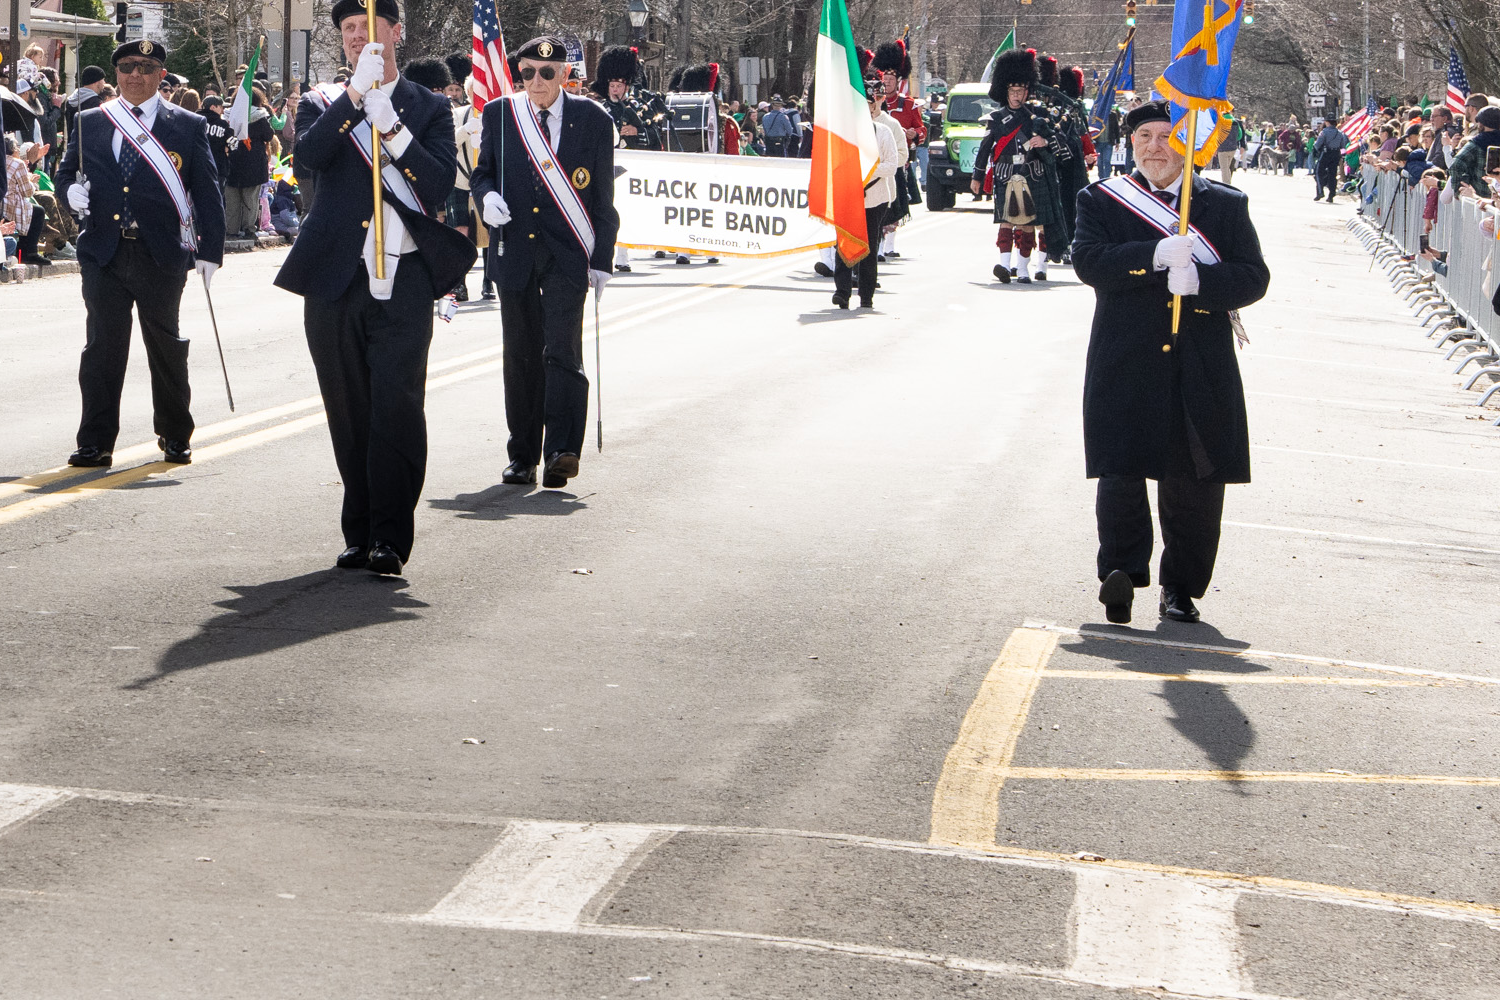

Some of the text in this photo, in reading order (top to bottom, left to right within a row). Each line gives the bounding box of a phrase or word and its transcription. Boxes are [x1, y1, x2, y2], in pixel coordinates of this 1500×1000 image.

[628, 177, 809, 209] BLACK DIAMOND
[664, 206, 787, 237] PIPE BAND
[746, 241, 762, 250] PA
